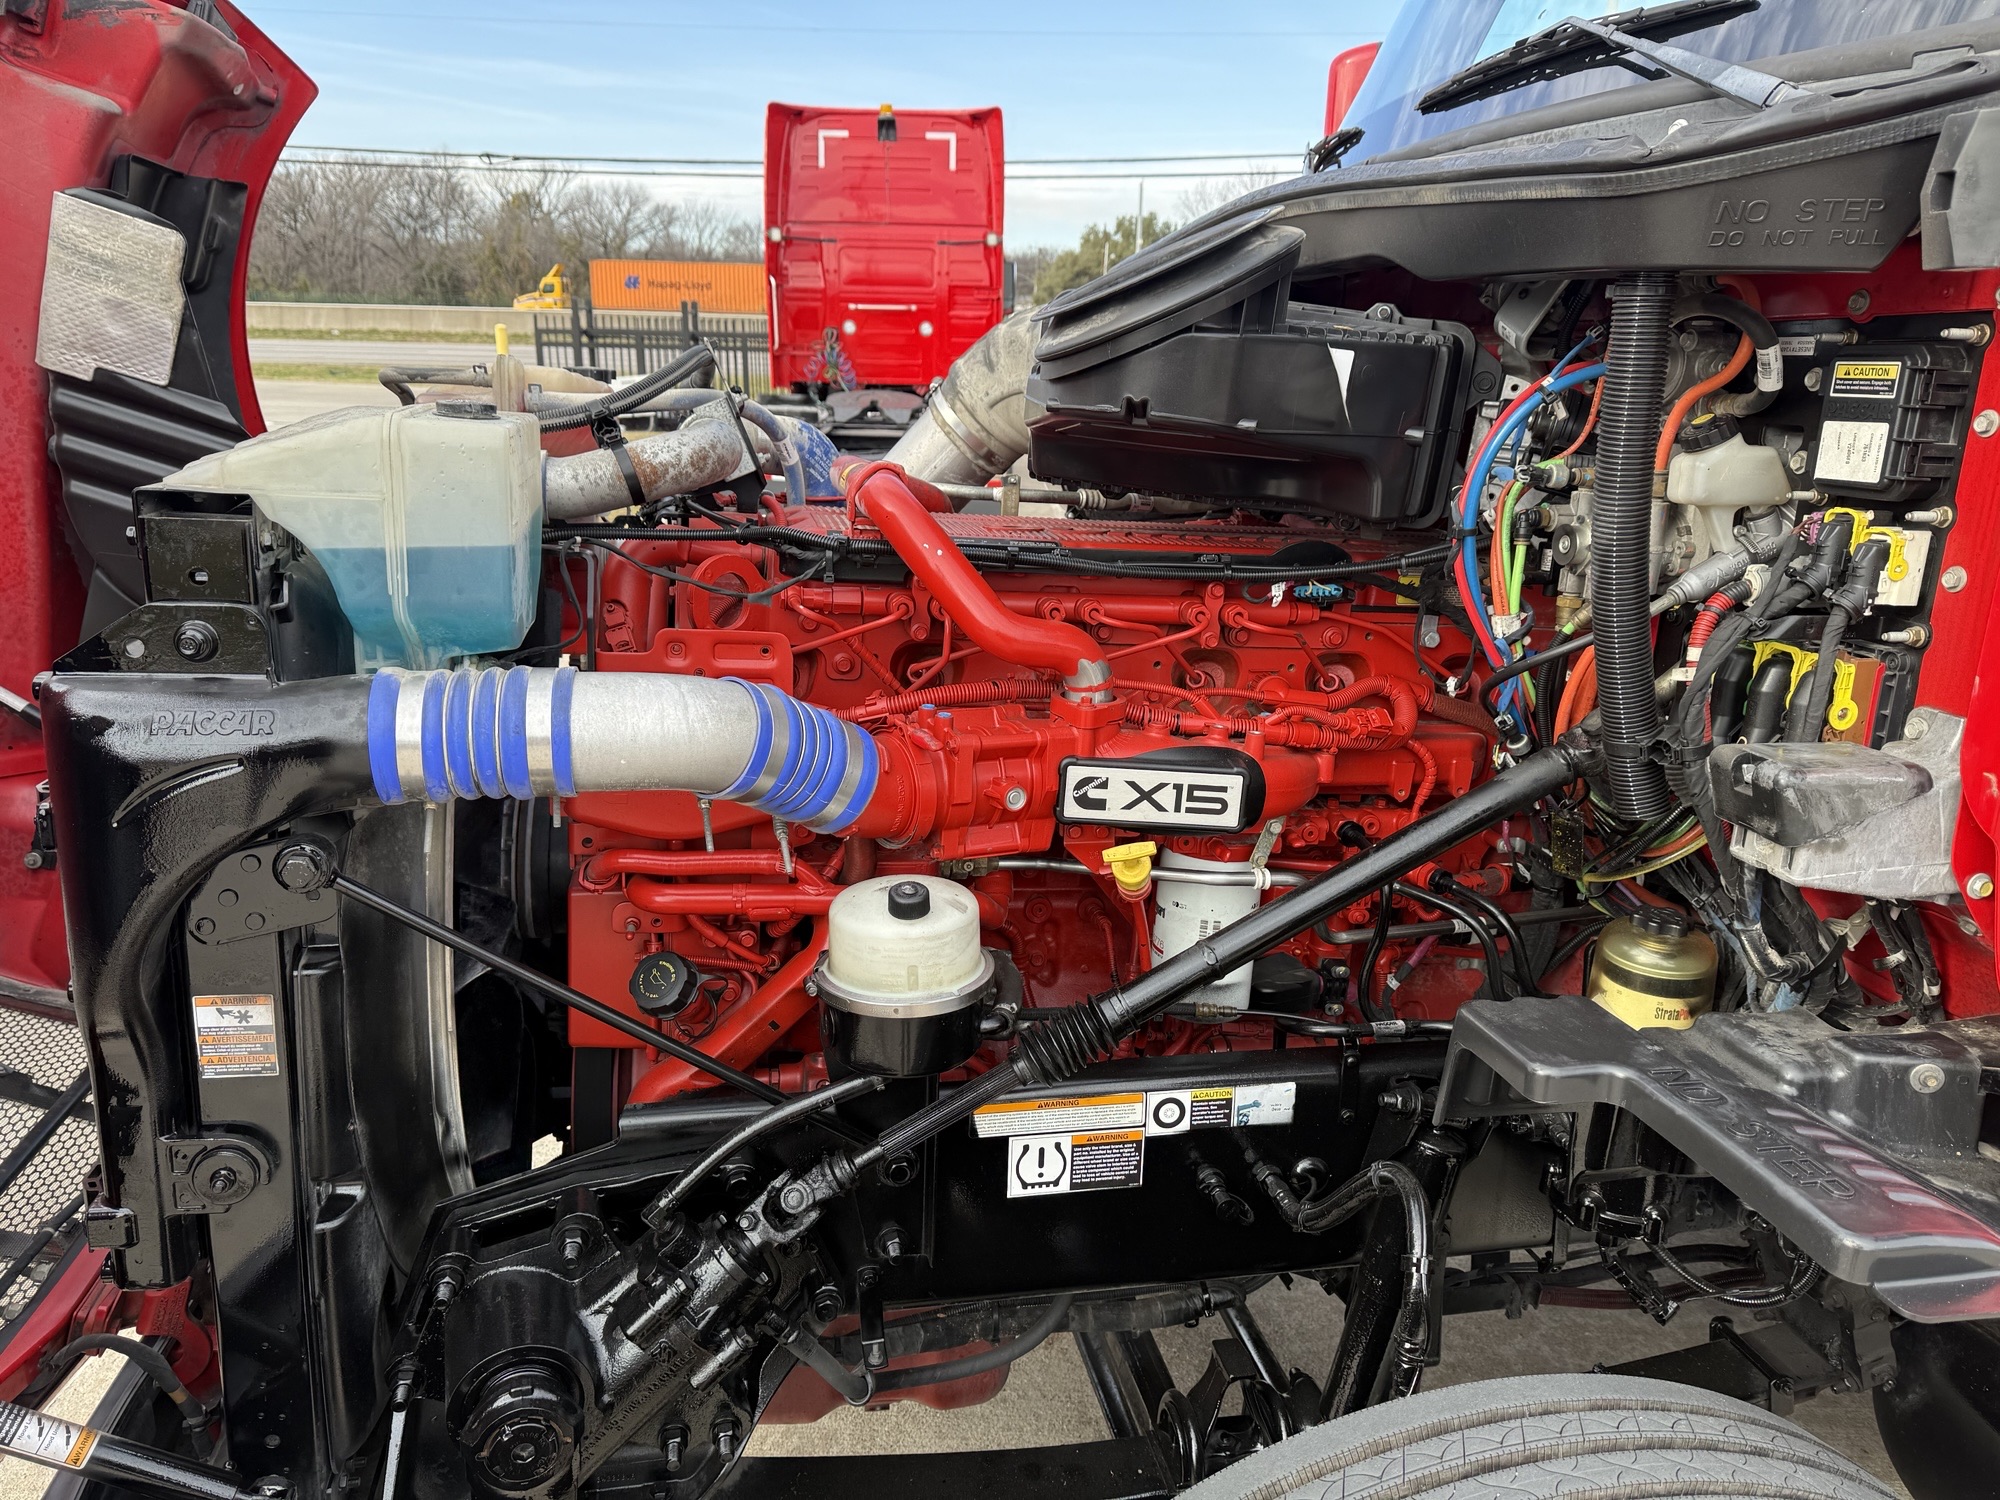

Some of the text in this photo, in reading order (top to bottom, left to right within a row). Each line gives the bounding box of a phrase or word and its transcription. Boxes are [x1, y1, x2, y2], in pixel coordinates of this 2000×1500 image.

[1714, 198, 1886, 224] NO STEP
[1707, 229, 1885, 247] DO NOT PULL
[1853, 367, 1890, 376] CAUTION
[150, 710, 275, 736] PACCAR
[1073, 776, 1107, 798] Cummins
[1120, 780, 1229, 816] X15
[659, 960, 675, 973] ENGINE
[220, 997, 258, 1005] WARNING
[211, 1034, 273, 1043] AVERTISSEMENT
[217, 1055, 271, 1063] ADVERTENCIA
[1200, 1091, 1232, 1099] CAUTION
[1043, 1100, 1079, 1108] WARNING
[1648, 1067, 1855, 1199] NO STEP
[17, 1424, 28, 1440] Hood
[43, 1436, 55, 1451] Hood
